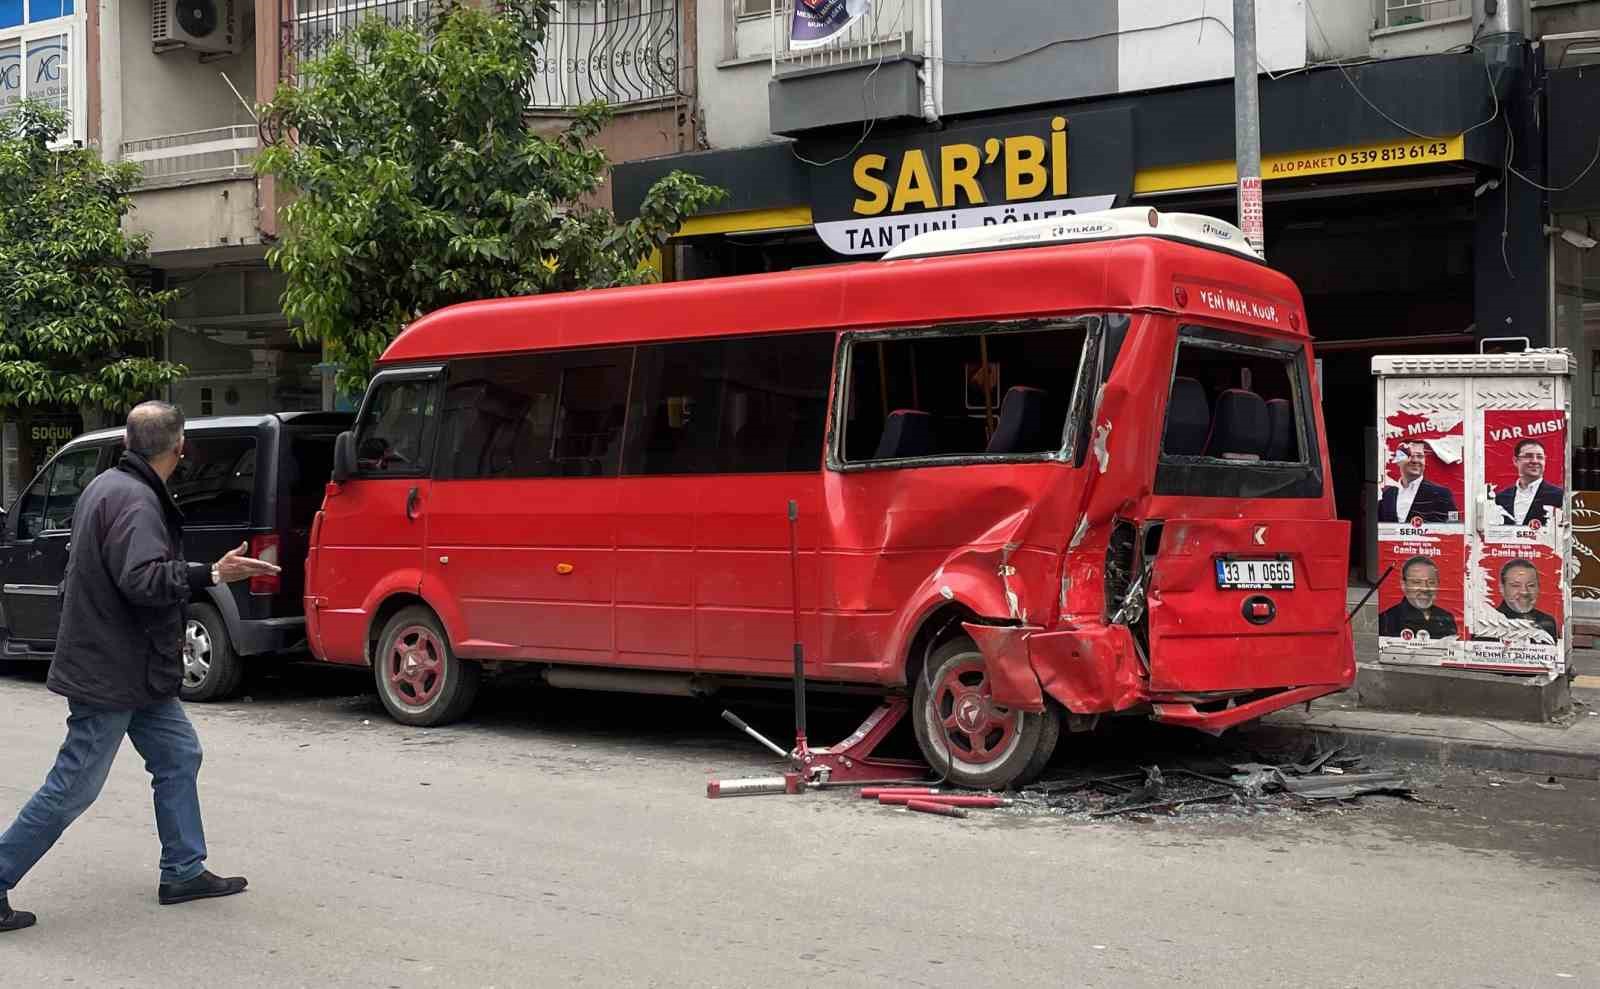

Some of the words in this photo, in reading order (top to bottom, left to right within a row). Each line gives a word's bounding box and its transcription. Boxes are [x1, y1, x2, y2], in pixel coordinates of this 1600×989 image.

[852, 115, 1069, 216] SAR'Bİ
[1272, 162, 1295, 174] ALO
[1297, 157, 1335, 171] PAKET
[1337, 153, 1347, 166] 0
[1350, 150, 1378, 165] 539
[1381, 147, 1406, 161] 813
[1409, 145, 1425, 158] 61
[1428, 142, 1448, 156] 43
[1200, 289, 1225, 311] YENİ
[1226, 297, 1252, 317] MAH.
[1489, 426, 1523, 441] VAR
[1225, 563, 1240, 581] 33
[1247, 563, 1256, 581] M
[1262, 563, 1290, 581] 0656
